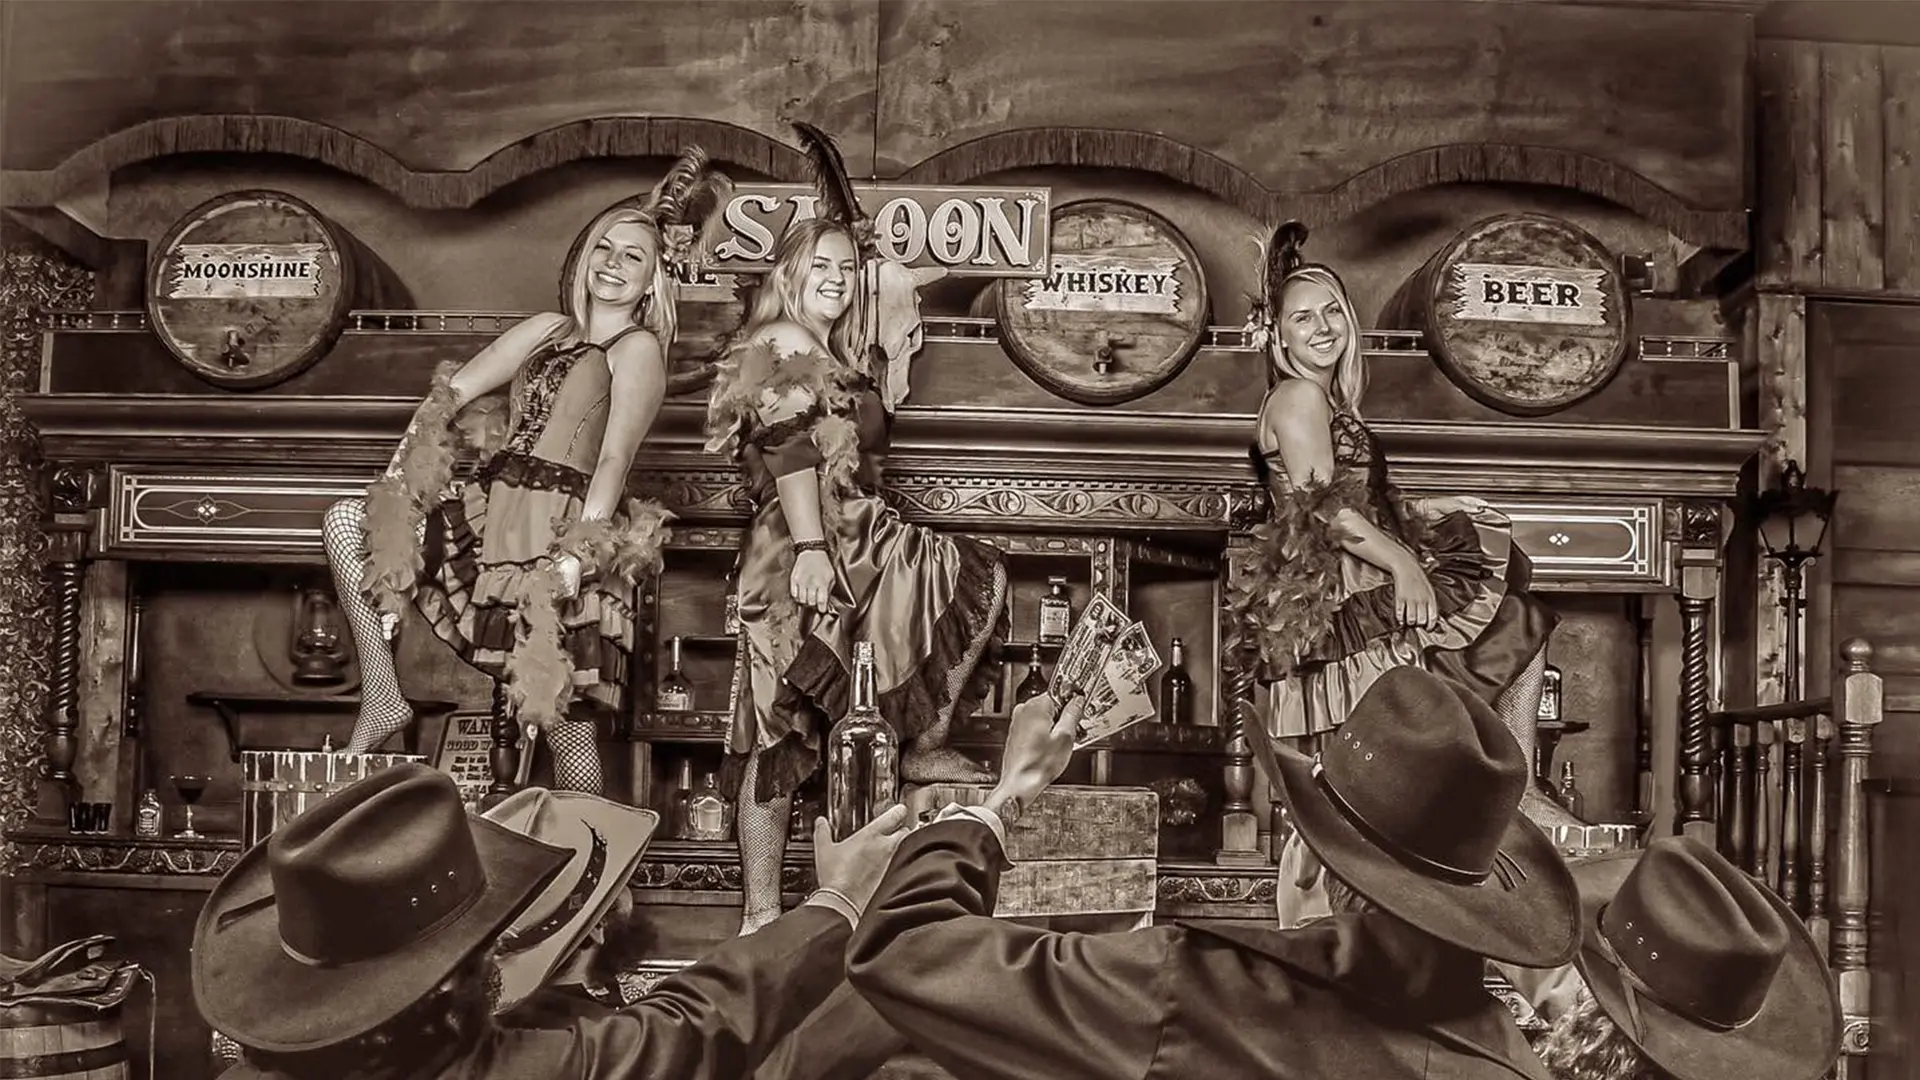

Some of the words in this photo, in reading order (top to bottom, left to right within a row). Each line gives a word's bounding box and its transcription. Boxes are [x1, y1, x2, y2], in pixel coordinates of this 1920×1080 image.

[715, 194, 1040, 266] SOON
[183, 262, 310, 279] MOONSHINE
[1041, 271, 1168, 295] WHISKEY
[1483, 279, 1581, 308] BEER
[458, 719, 491, 735] WAN
